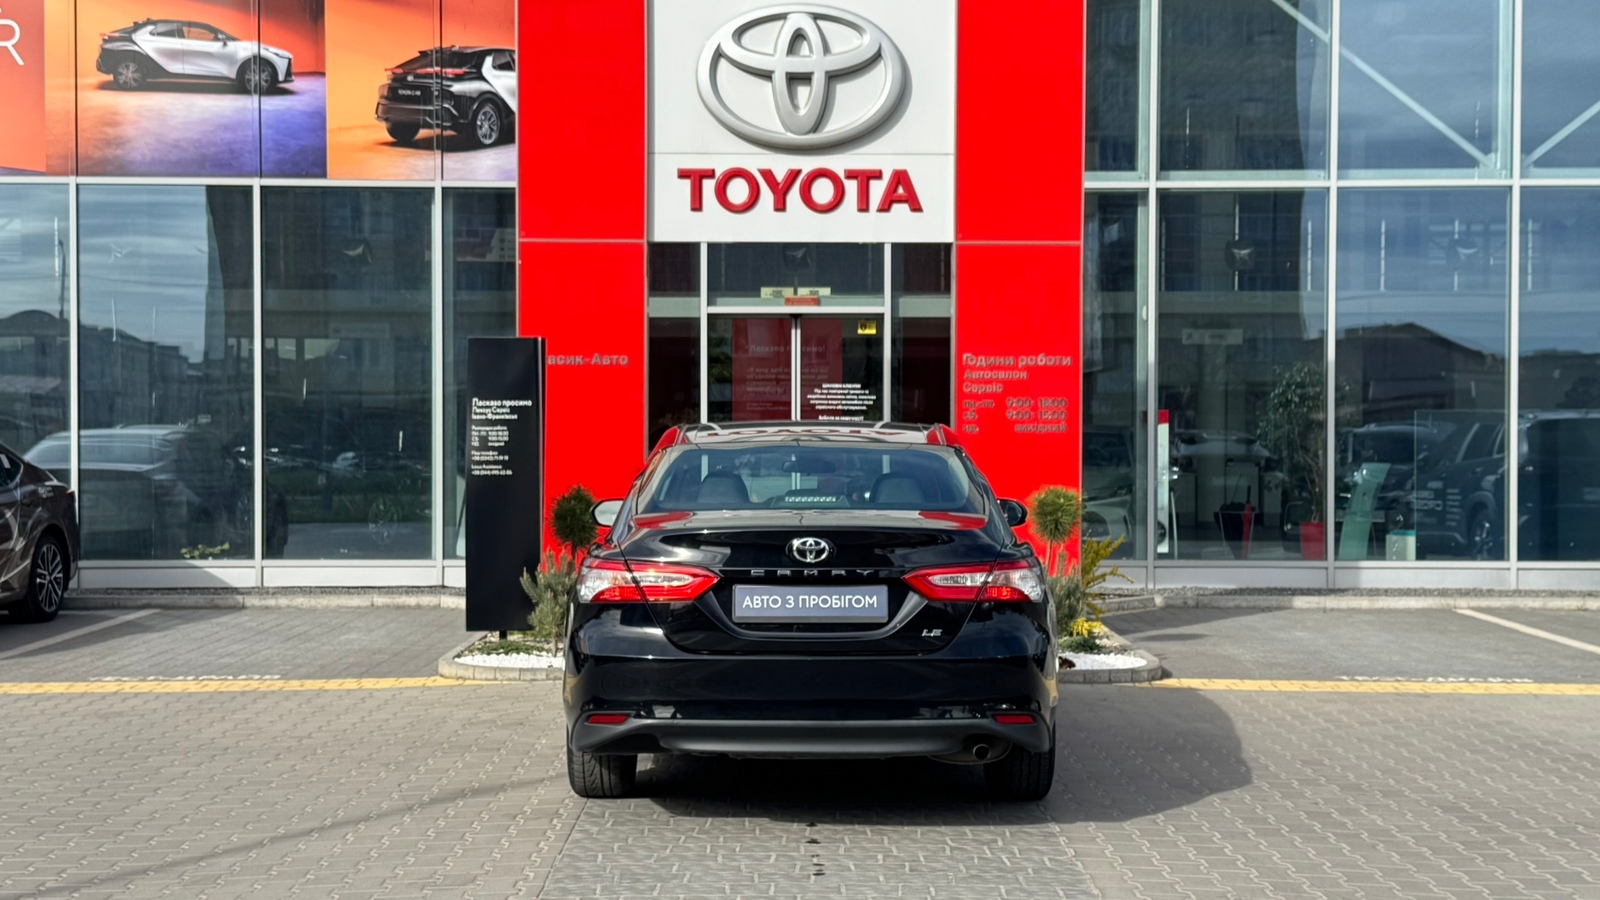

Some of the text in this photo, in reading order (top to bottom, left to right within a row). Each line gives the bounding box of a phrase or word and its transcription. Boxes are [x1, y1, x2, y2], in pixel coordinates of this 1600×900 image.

[677, 167, 924, 214] TOYOTA
[962, 352, 1072, 368] Години роботи
[963, 369, 1029, 380] Автосалон
[962, 381, 1004, 396] Сервіс
[742, 595, 877, 608] АВТО З ПРОБІГОМ
[922, 628, 942, 637] LE
